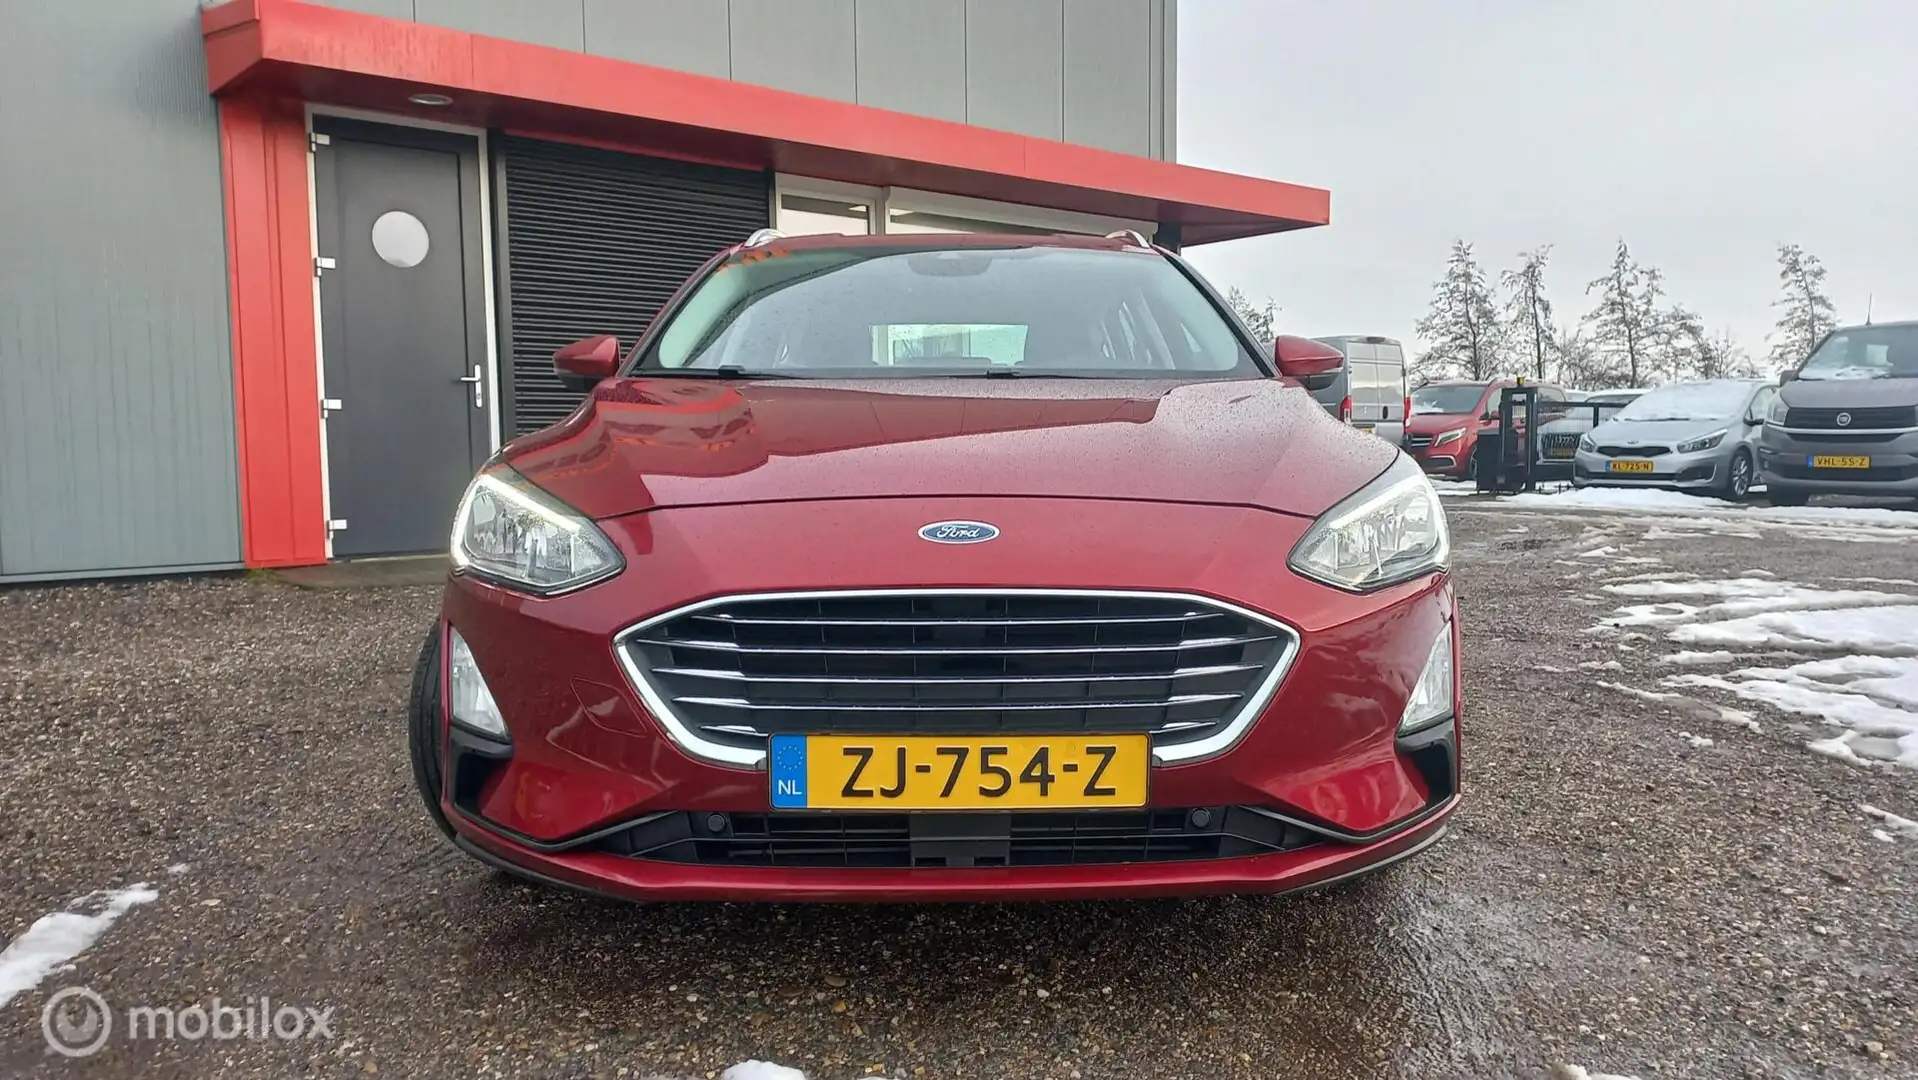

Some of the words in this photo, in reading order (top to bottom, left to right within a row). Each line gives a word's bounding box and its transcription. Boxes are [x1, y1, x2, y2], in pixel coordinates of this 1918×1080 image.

[936, 525, 980, 538] Ford
[841, 745, 1117, 798] ZJ-754-Z
[778, 779, 802, 795] NL
